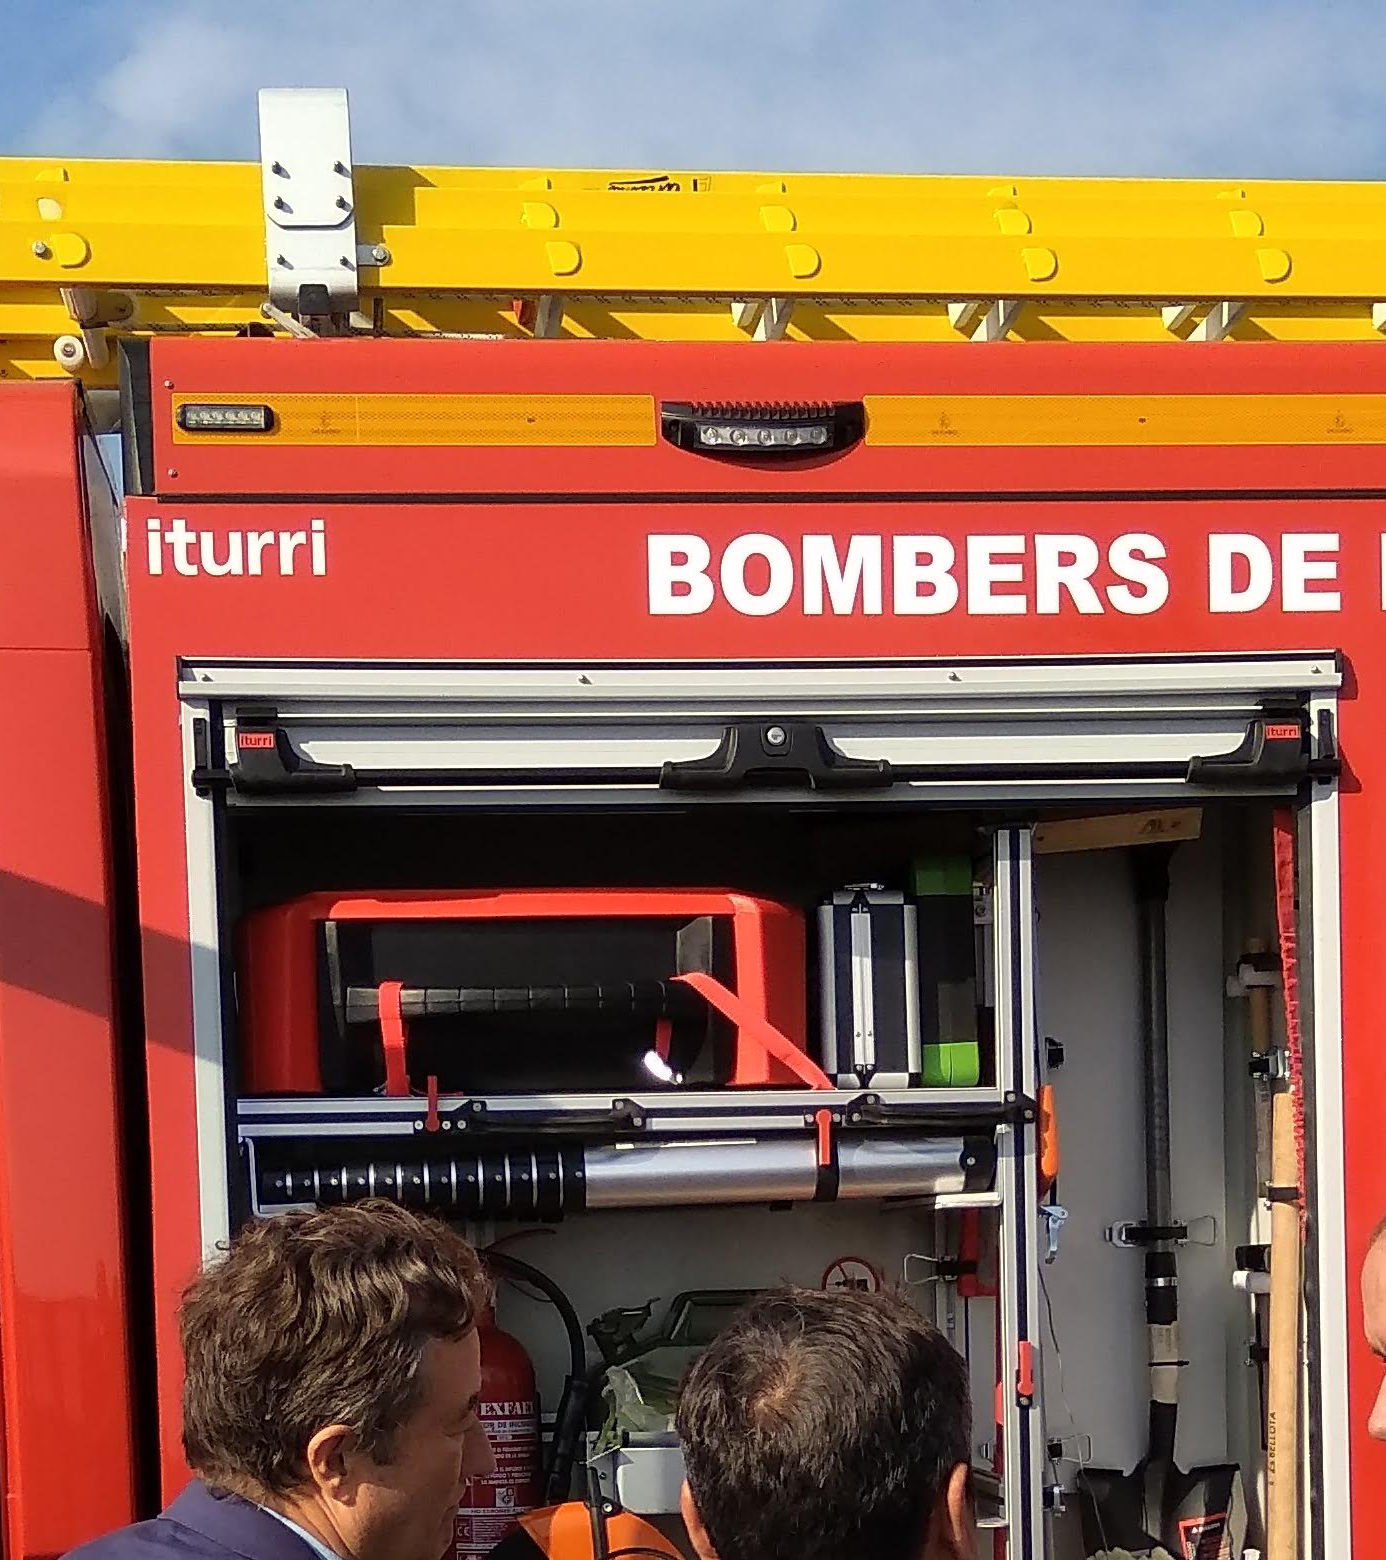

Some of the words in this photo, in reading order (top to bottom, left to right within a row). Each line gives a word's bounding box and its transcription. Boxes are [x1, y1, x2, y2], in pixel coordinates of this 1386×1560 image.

[147, 518, 327, 576] iturri
[647, 533, 1169, 616] BOMBERS
[1208, 533, 1341, 613] DE
[241, 735, 272, 746] iturri
